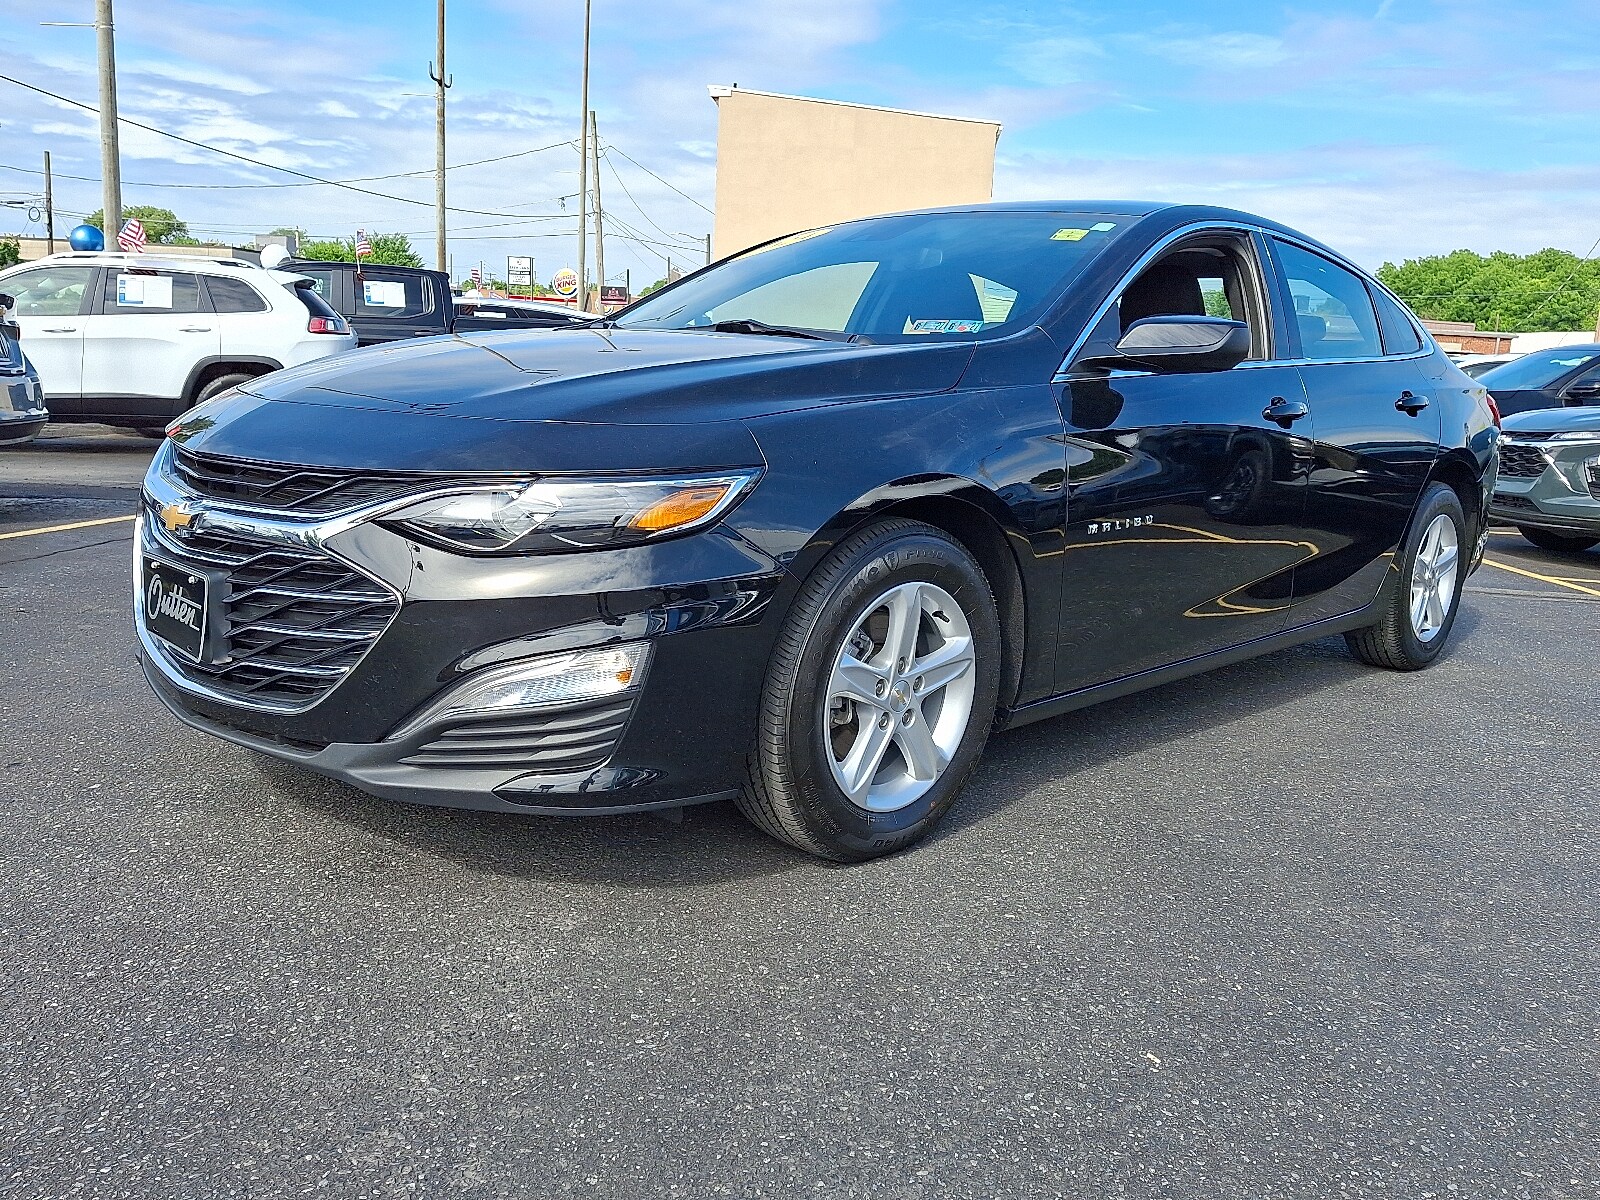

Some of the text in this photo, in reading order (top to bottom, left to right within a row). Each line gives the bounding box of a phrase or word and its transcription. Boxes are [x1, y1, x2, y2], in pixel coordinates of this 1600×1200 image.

[556, 274, 576, 283] BURGER
[556, 279, 577, 289] KING
[1087, 515, 1153, 534] MALIBU
[148, 574, 202, 631] Outten
